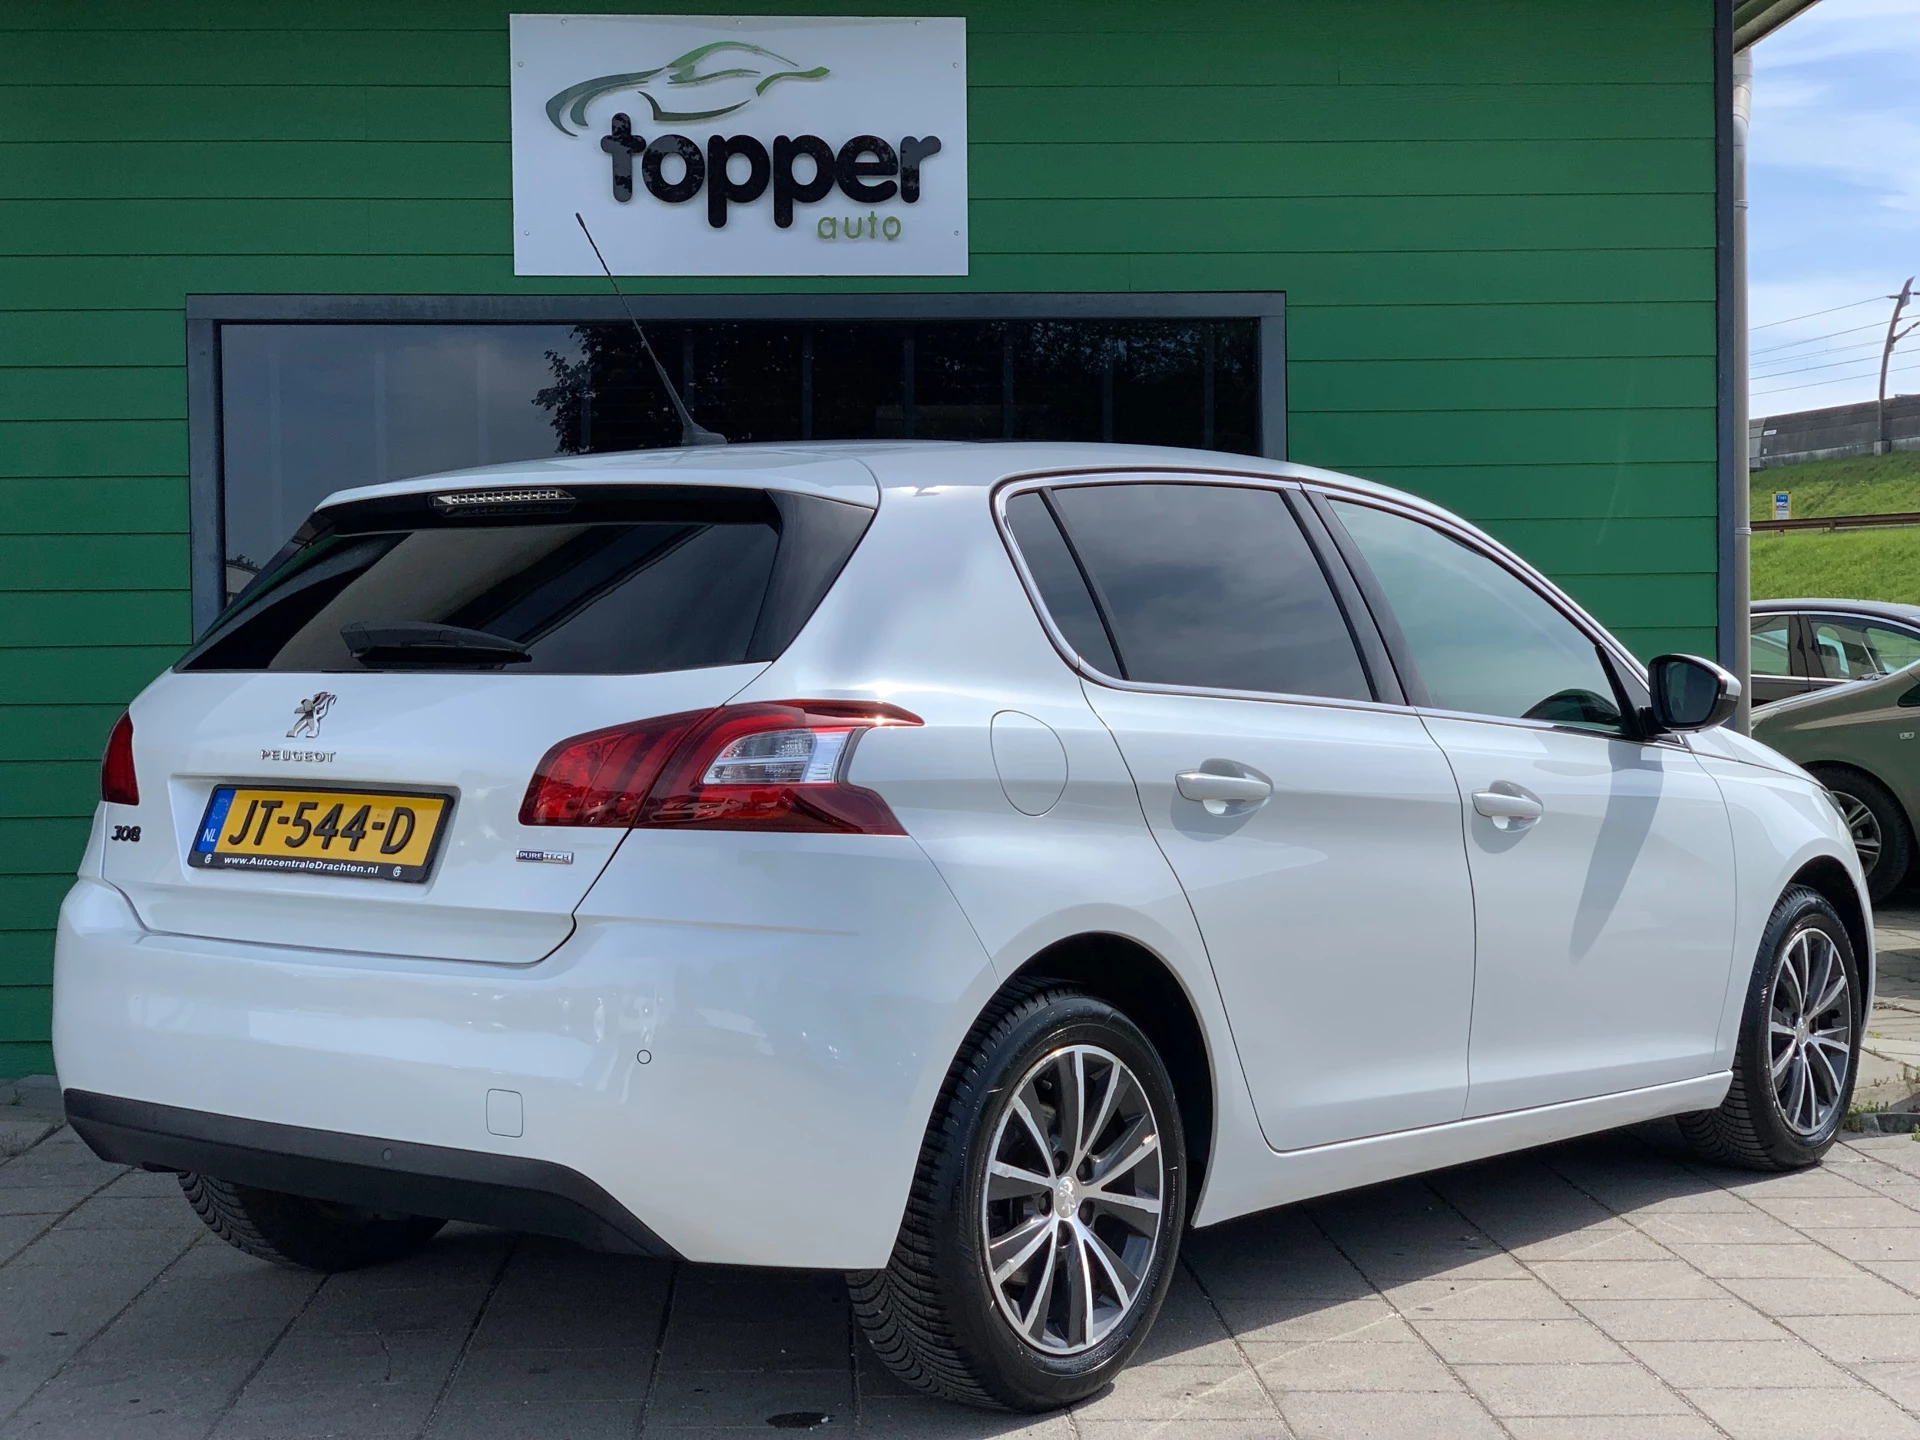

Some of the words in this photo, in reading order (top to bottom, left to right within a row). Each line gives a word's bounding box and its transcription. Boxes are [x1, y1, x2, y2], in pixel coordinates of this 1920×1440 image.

[600, 112, 942, 229] topper
[816, 210, 901, 241] auto
[260, 749, 337, 763] PEUGEOT
[110, 825, 142, 842] 308
[202, 827, 216, 843] NL
[227, 799, 416, 855] JT-544-D
[224, 855, 379, 875] www.AutocentraleDrachten.nl
